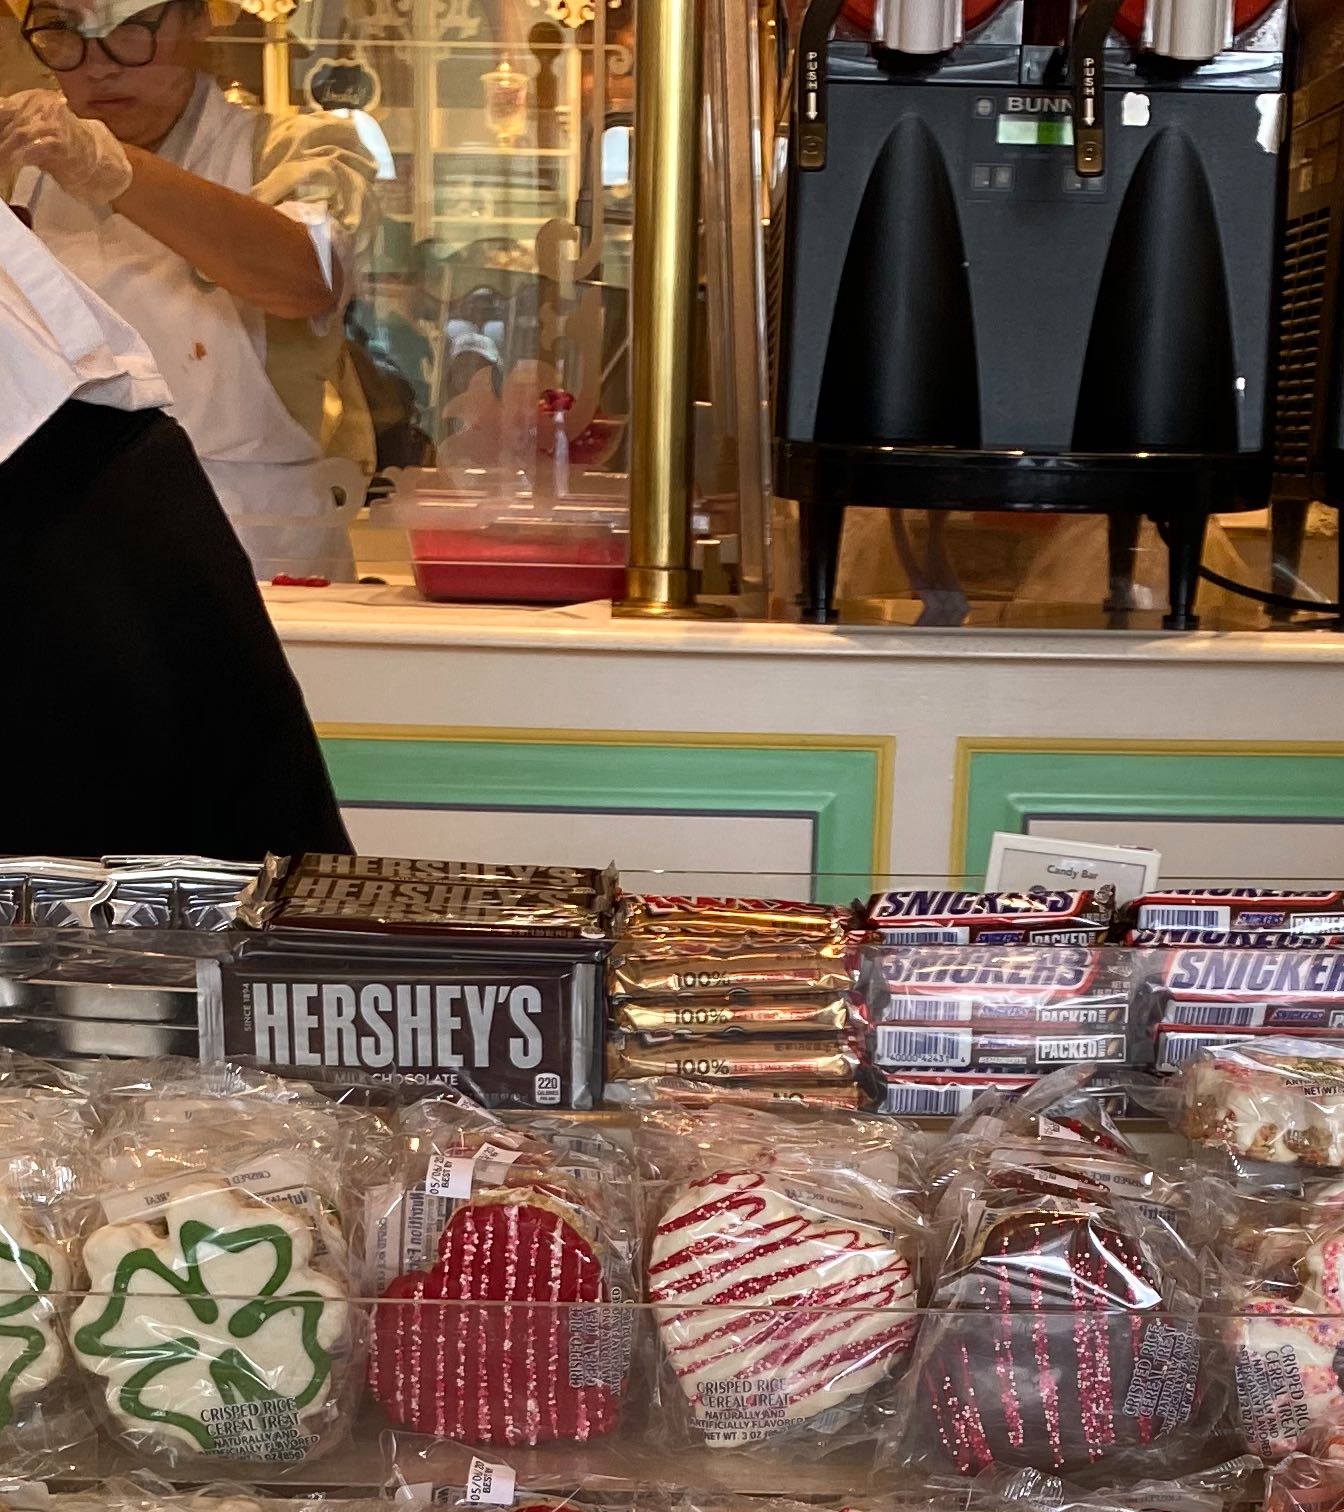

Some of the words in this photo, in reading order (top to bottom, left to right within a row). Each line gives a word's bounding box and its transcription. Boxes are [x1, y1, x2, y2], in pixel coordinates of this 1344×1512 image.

[808, 52, 818, 89] PUSH
[1084, 58, 1094, 95] PUSH
[1047, 864, 1077, 879] Candy
[1081, 870, 1098, 879] Bar
[253, 983, 543, 1069] HERSHEY'S
[1041, 1040, 1097, 1059] PACKED
[674, 1059, 729, 1075] 100%
[334, 1073, 367, 1084] MILK
[372, 1073, 458, 1086] CHOCOLATE
[538, 1077, 558, 1090] 220
[440, 1171, 450, 1188] BEST
[569, 1337, 584, 1389] CRISPED
[1123, 1358, 1152, 1417] CRISPED
[1141, 1324, 1161, 1358] RICE
[1280, 1344, 1305, 1401] CRISPED
[697, 1380, 752, 1395] CRISPED
[757, 1378, 787, 1392] RICE
[1139, 1365, 1166, 1418] CEREAL
[1265, 1350, 1287, 1397] CEREAL
[1278, 1402, 1297, 1439] TREAT
[201, 1403, 259, 1422] CRISPED
[263, 1398, 296, 1414] RICE
[751, 1392, 791, 1406] TREAT
[207, 1419, 258, 1436] CEREAL
[262, 1412, 300, 1429] TREAT
[705, 1409, 761, 1420] NATURALLY
[762, 1409, 785, 1418] AND
[1267, 1414, 1278, 1439] AND
[215, 1433, 273, 1448] NATURALLY
[275, 1429, 299, 1439] AND
